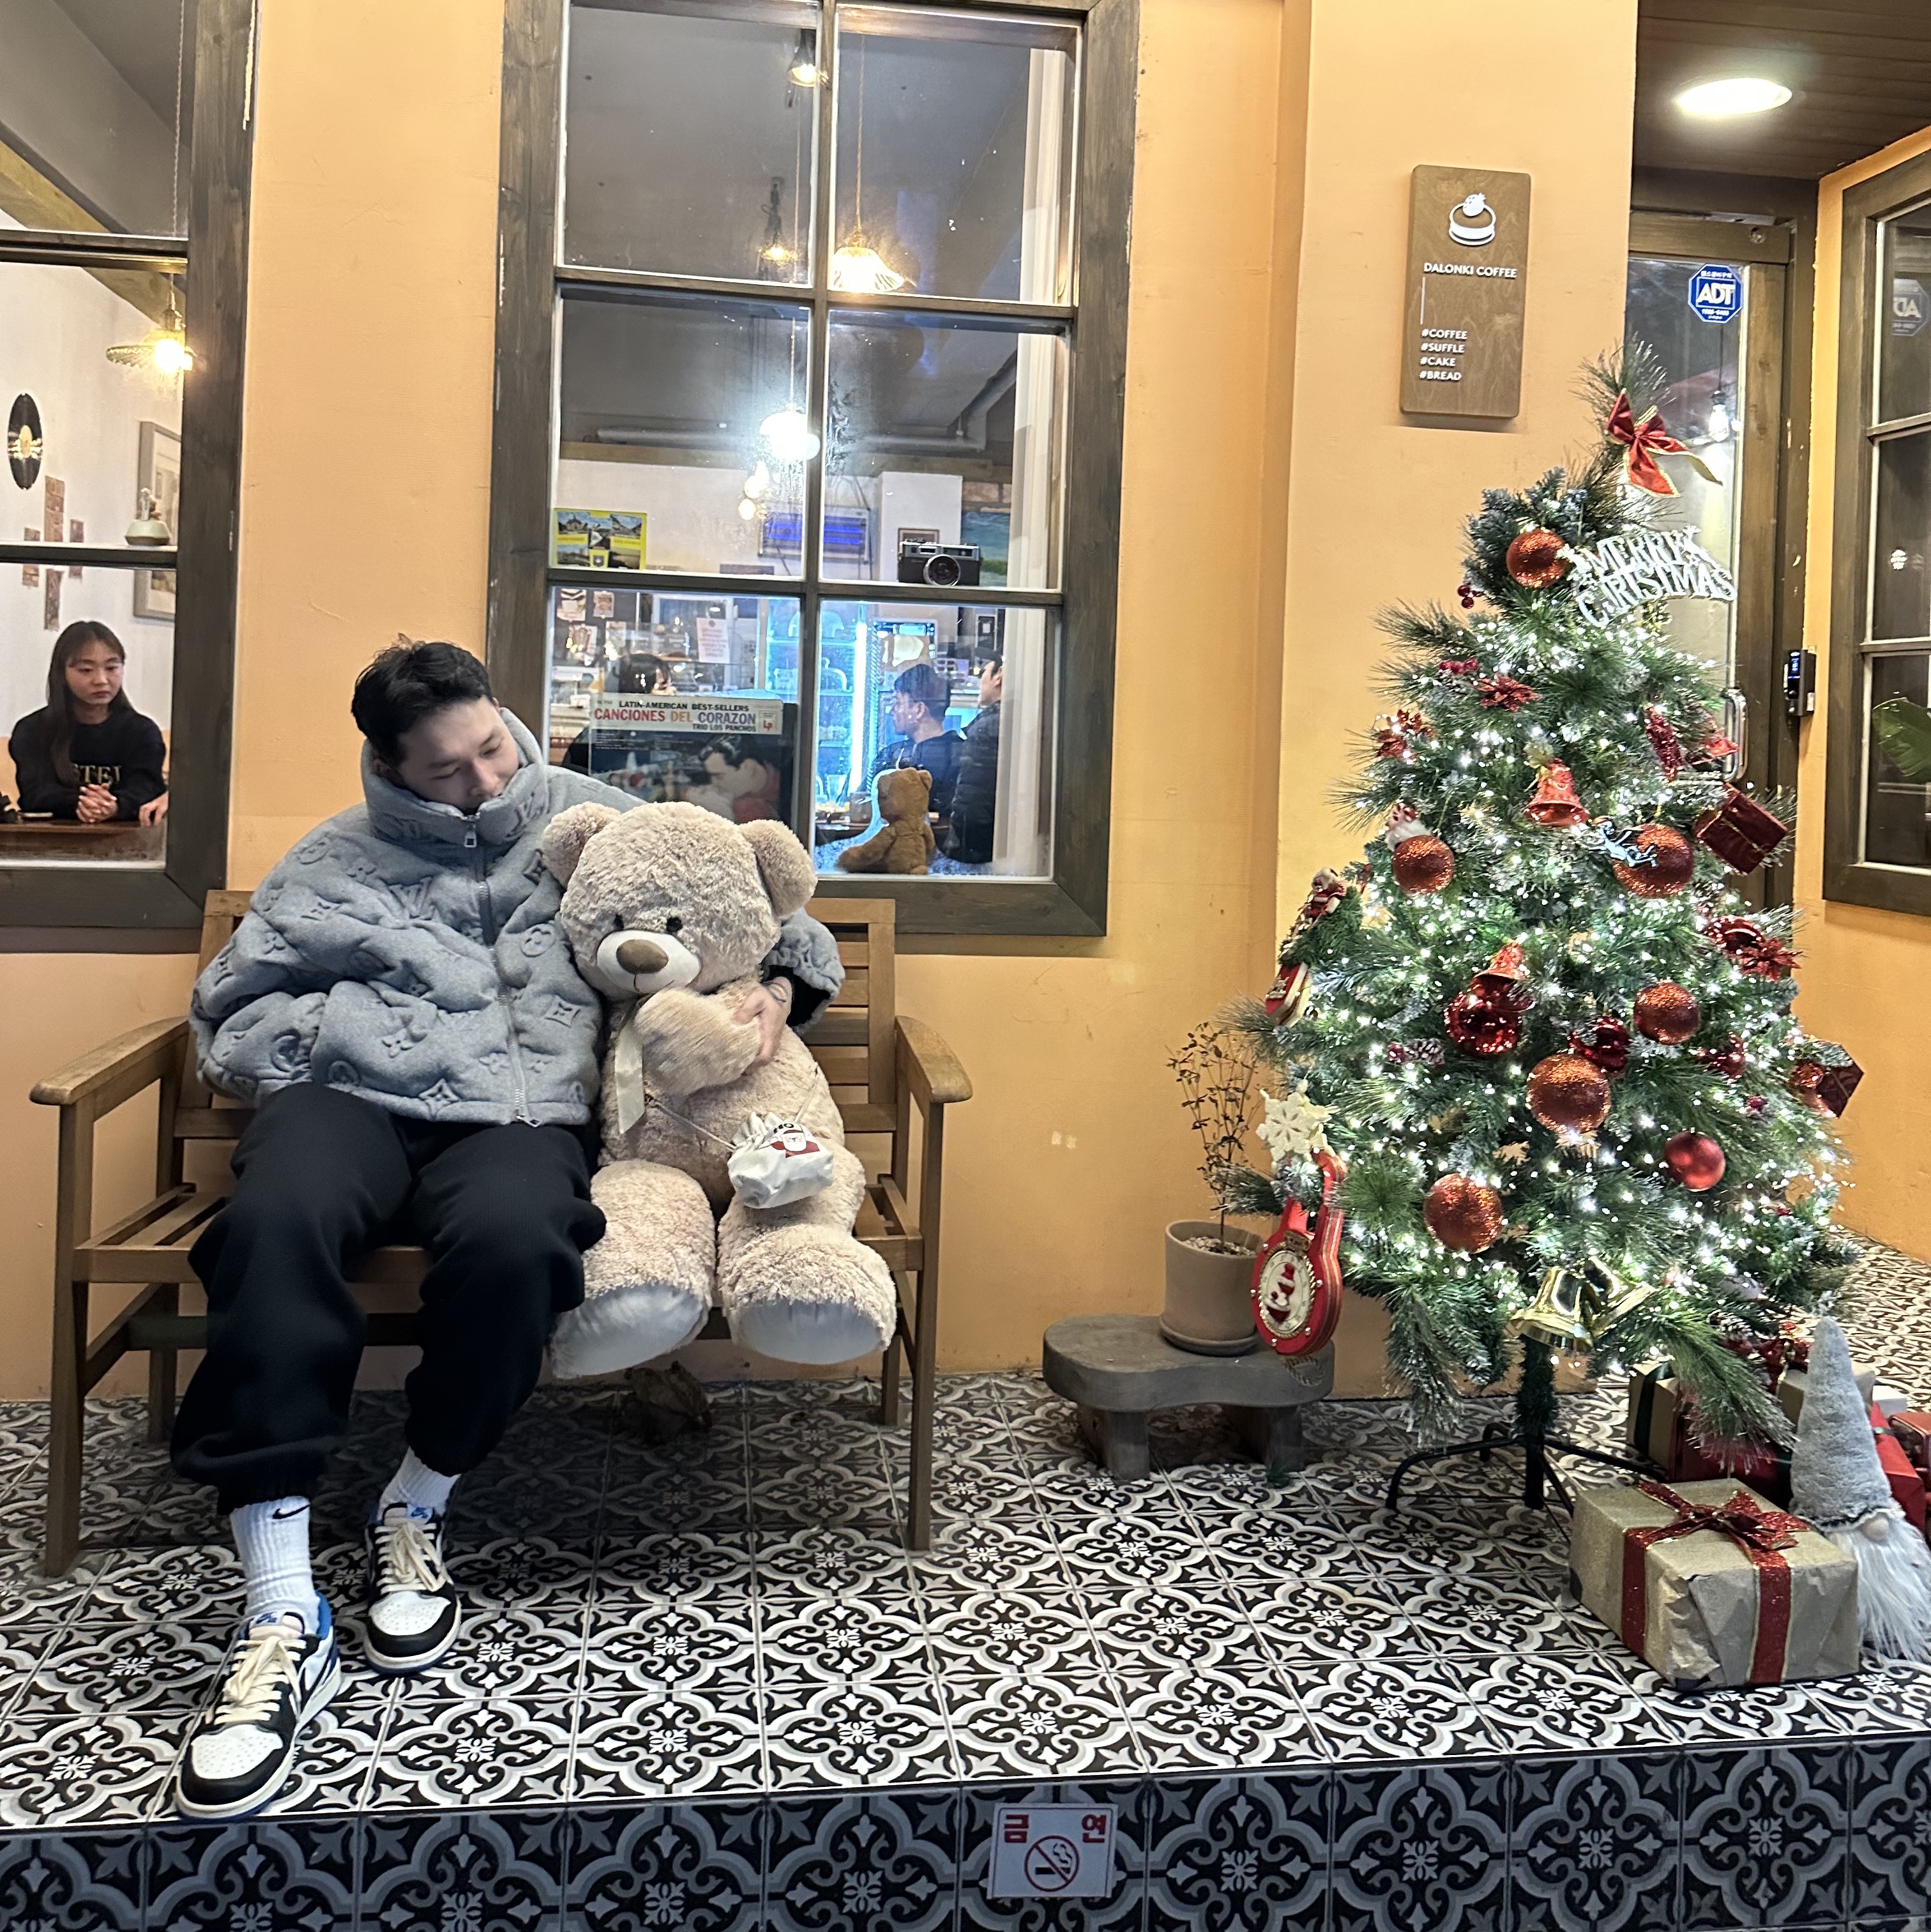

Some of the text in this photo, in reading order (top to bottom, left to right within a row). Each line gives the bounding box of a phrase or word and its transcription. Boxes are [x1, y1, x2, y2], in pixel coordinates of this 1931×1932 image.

[1424, 262, 1517, 278] DALONKI COFFEE
[1696, 282, 1736, 305] ADT
[1421, 329, 1468, 340] #COFFEE
[1420, 342, 1465, 353] #SUFFLE
[1420, 357, 1457, 367] #CAKE
[1419, 370, 1462, 381] #BREAD
[619, 701, 688, 710] LATIN-AMERICAN
[692, 703, 749, 712] BEST-SELLERS
[594, 708, 665, 722] CANCIONES
[670, 711, 693, 722] DEL
[698, 712, 756, 724] CORAZON
[1004, 1814, 1107, 1843] 금 연
